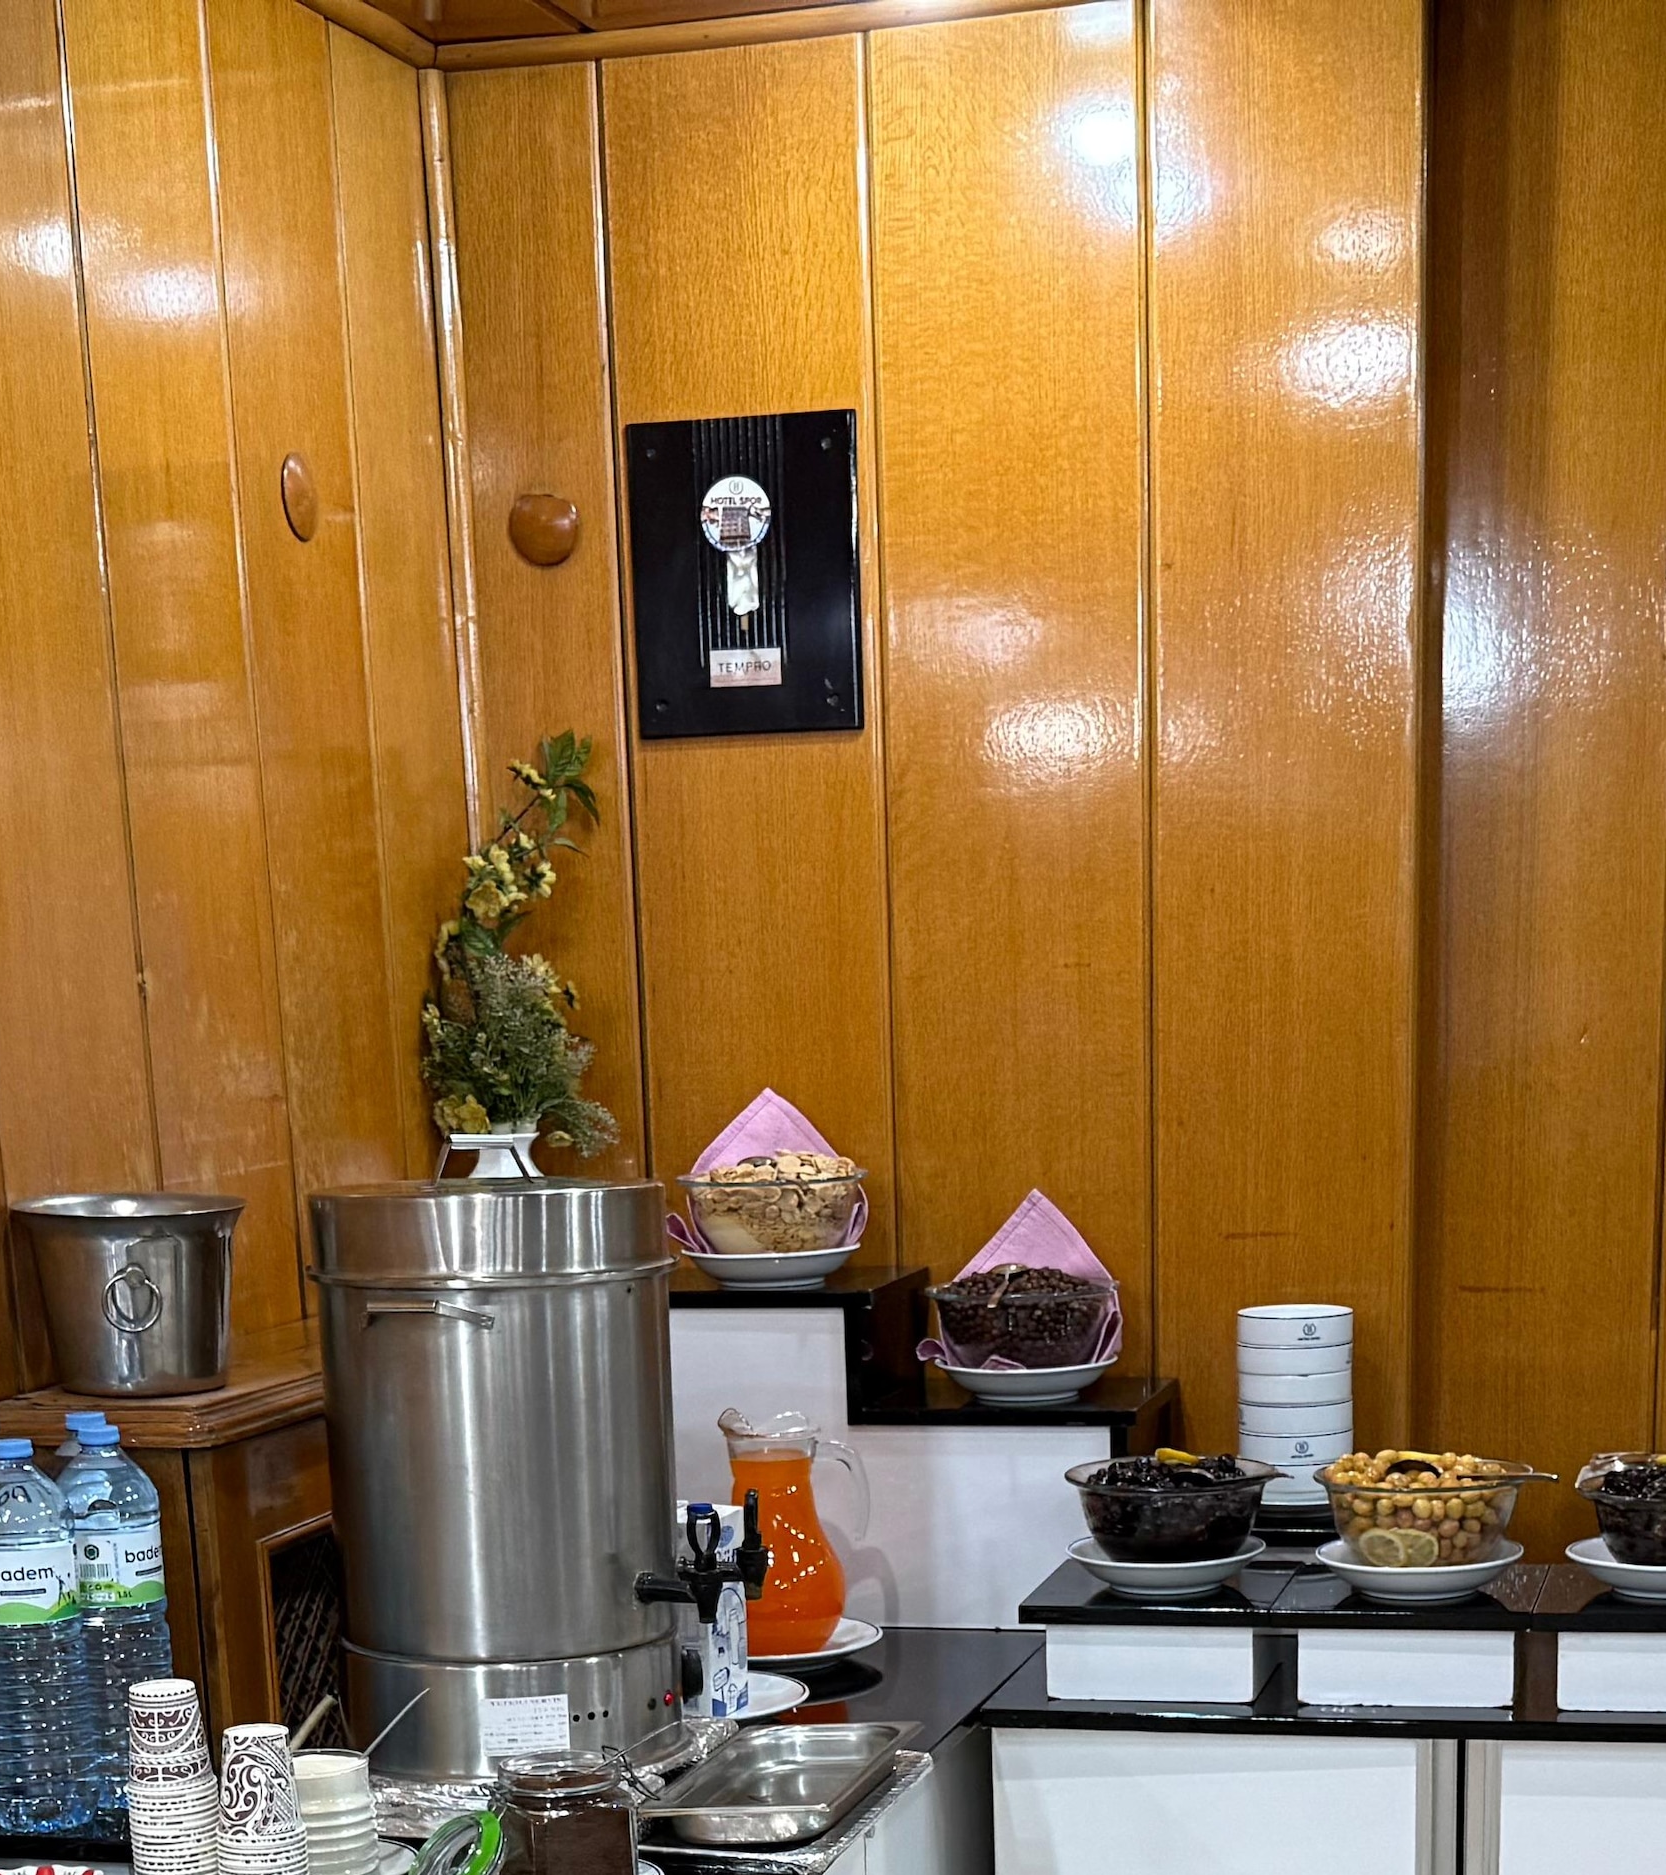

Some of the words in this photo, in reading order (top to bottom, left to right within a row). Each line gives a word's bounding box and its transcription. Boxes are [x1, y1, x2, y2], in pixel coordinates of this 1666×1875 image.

[711, 496, 737, 505] HOTEL
[739, 496, 762, 505] SPOR
[718, 660, 772, 673] TEMPRO
